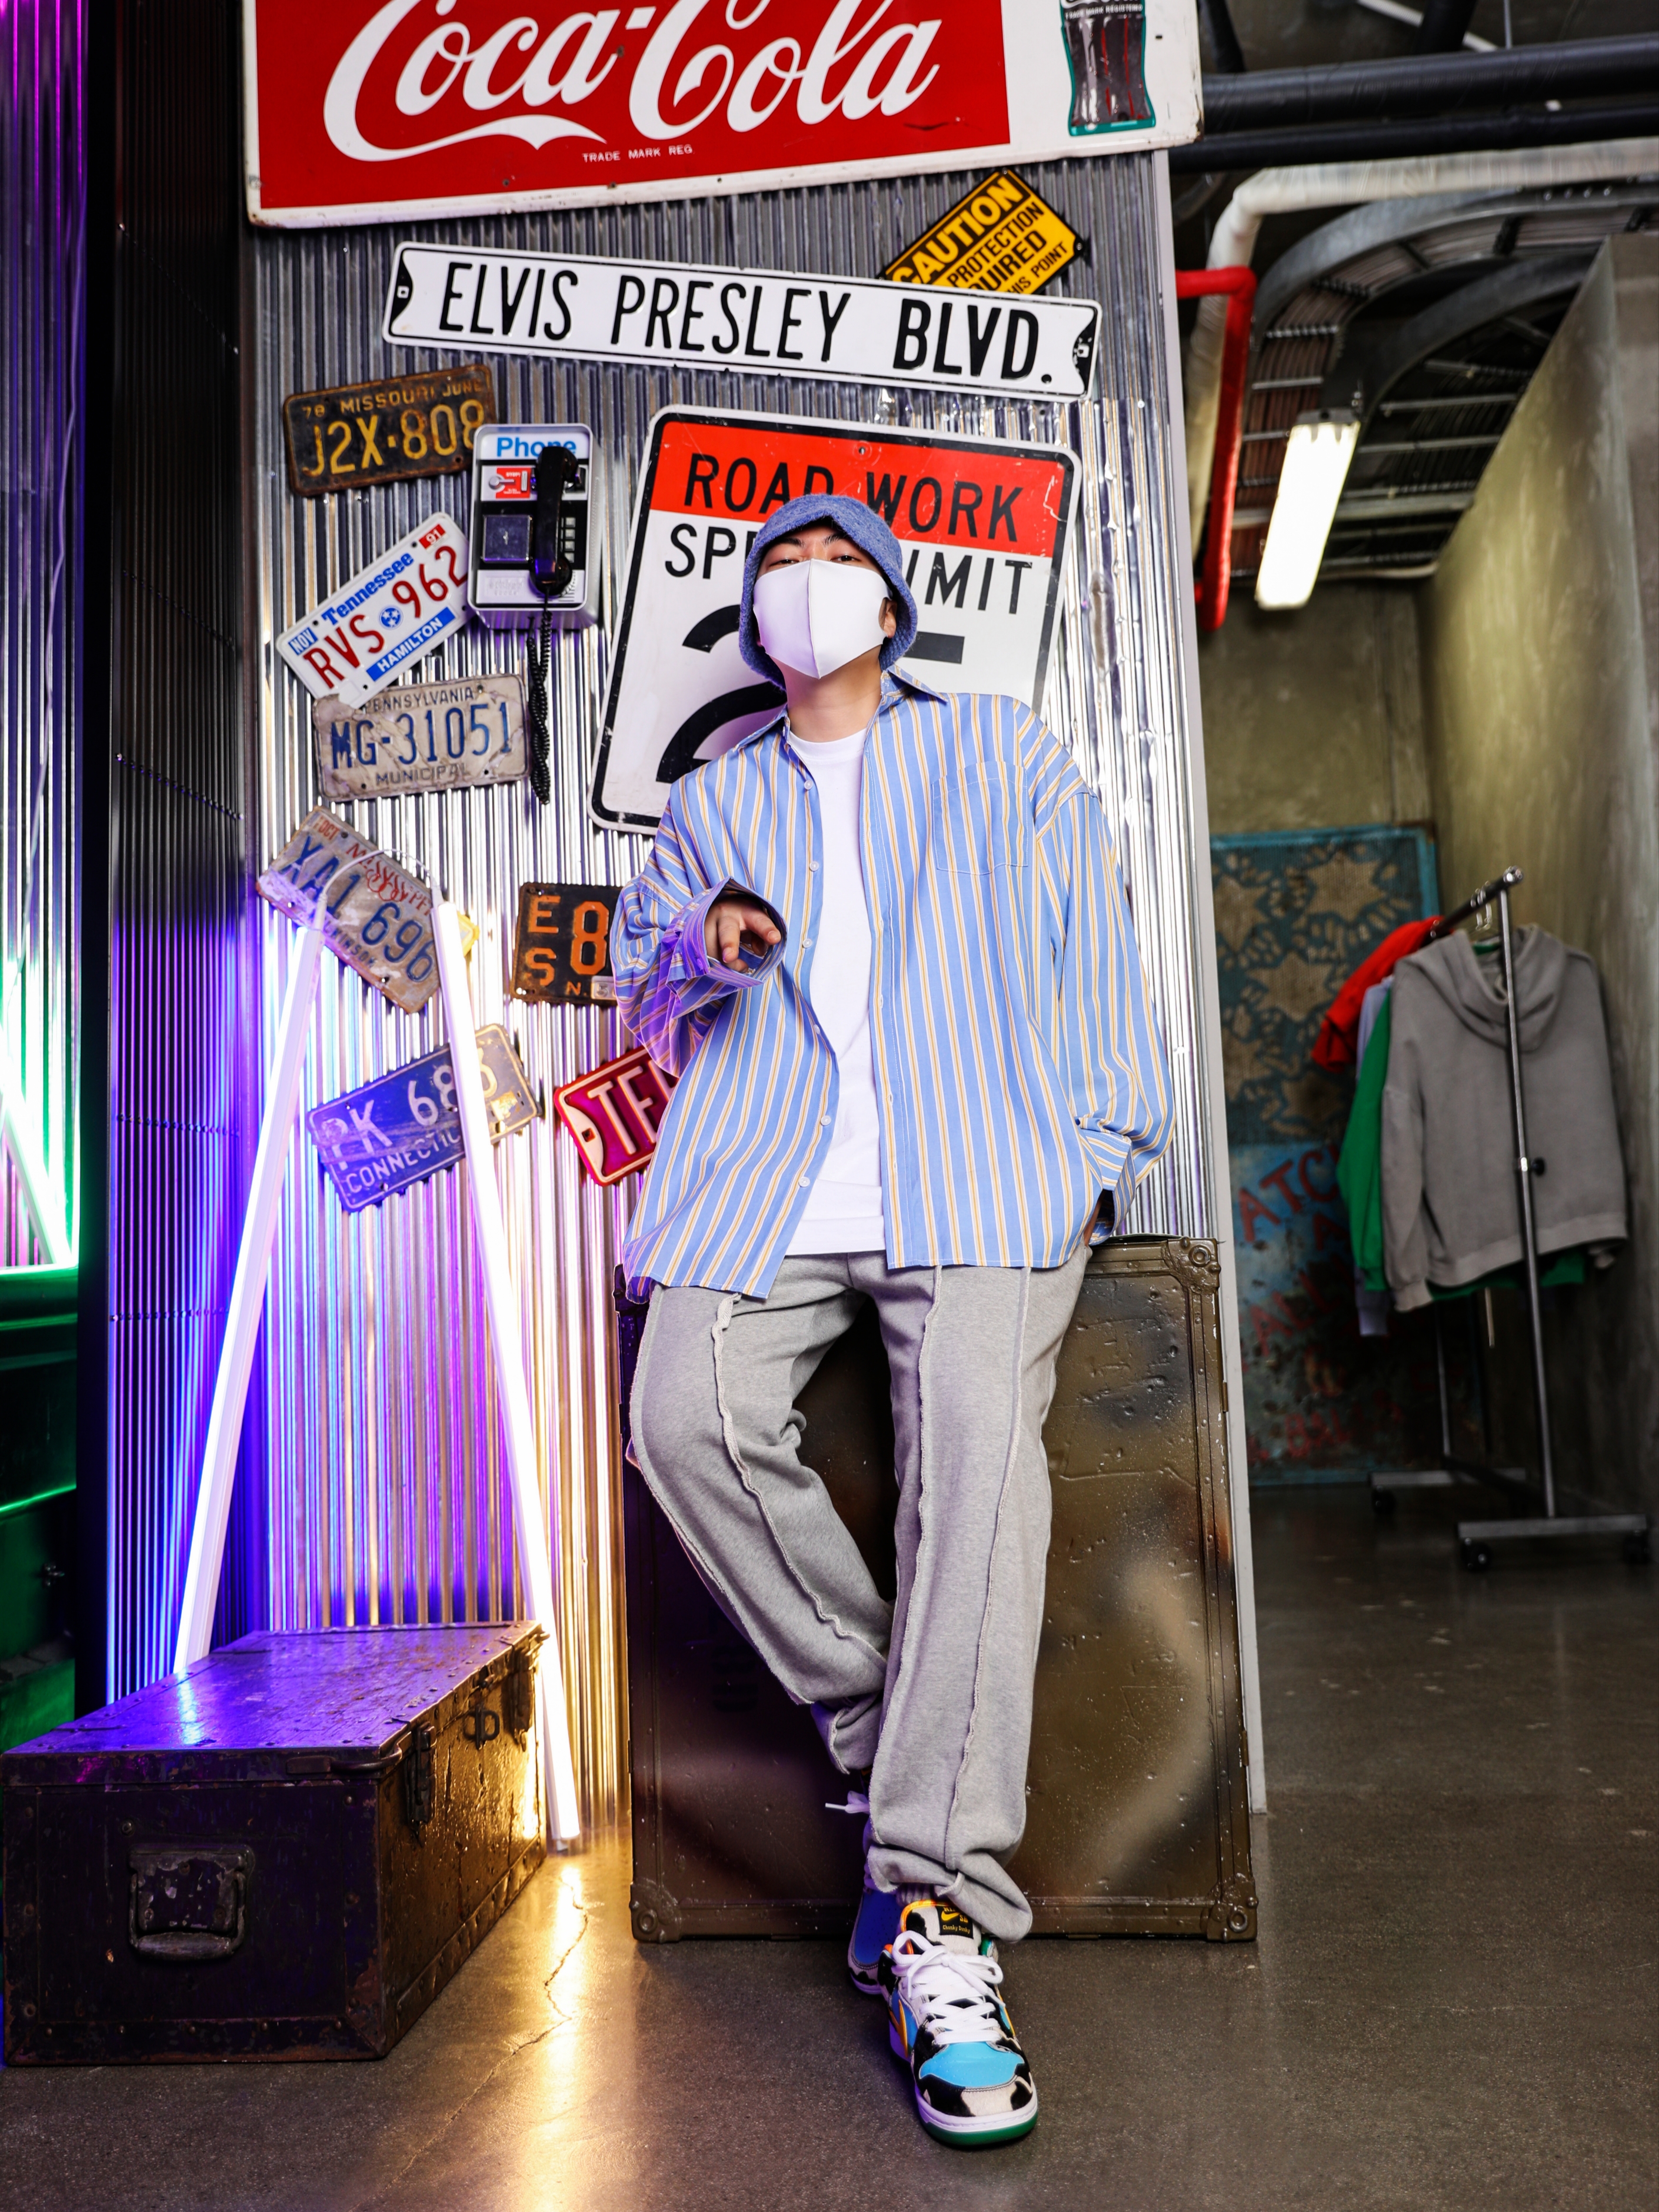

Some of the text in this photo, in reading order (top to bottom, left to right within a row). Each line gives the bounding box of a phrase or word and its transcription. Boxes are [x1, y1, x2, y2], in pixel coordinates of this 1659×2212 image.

[323, 0, 942, 162] Coca-Cola
[582, 151, 621, 162] TRADE
[628, 147, 661, 159] MARK
[892, 177, 1024, 284] CAUTION
[947, 202, 1045, 288] PROTECTION
[968, 229, 1047, 291] UIRED
[1006, 241, 1068, 294] HIS POINT
[439, 262, 1053, 385] ELVIS PRESLEY BLVD.
[340, 385, 435, 414] MISSOURI
[442, 379, 482, 397] JUNE
[684, 452, 1024, 542] ROAD WORK
[425, 528, 442, 544] 91
[321, 552, 414, 626] Tennessee
[905, 549, 1033, 614] IMIT
[289, 628, 317, 654] NOV
[302, 545, 468, 689] RVS 962
[377, 617, 444, 672] HAMILTON
[365, 687, 474, 712] PENNSYLVANIA
[331, 702, 511, 769] MG-31051
[375, 762, 470, 786] MUNICIPAL
[362, 902, 434, 983] 696
[346, 1129, 461, 1193] CONNECTIC
